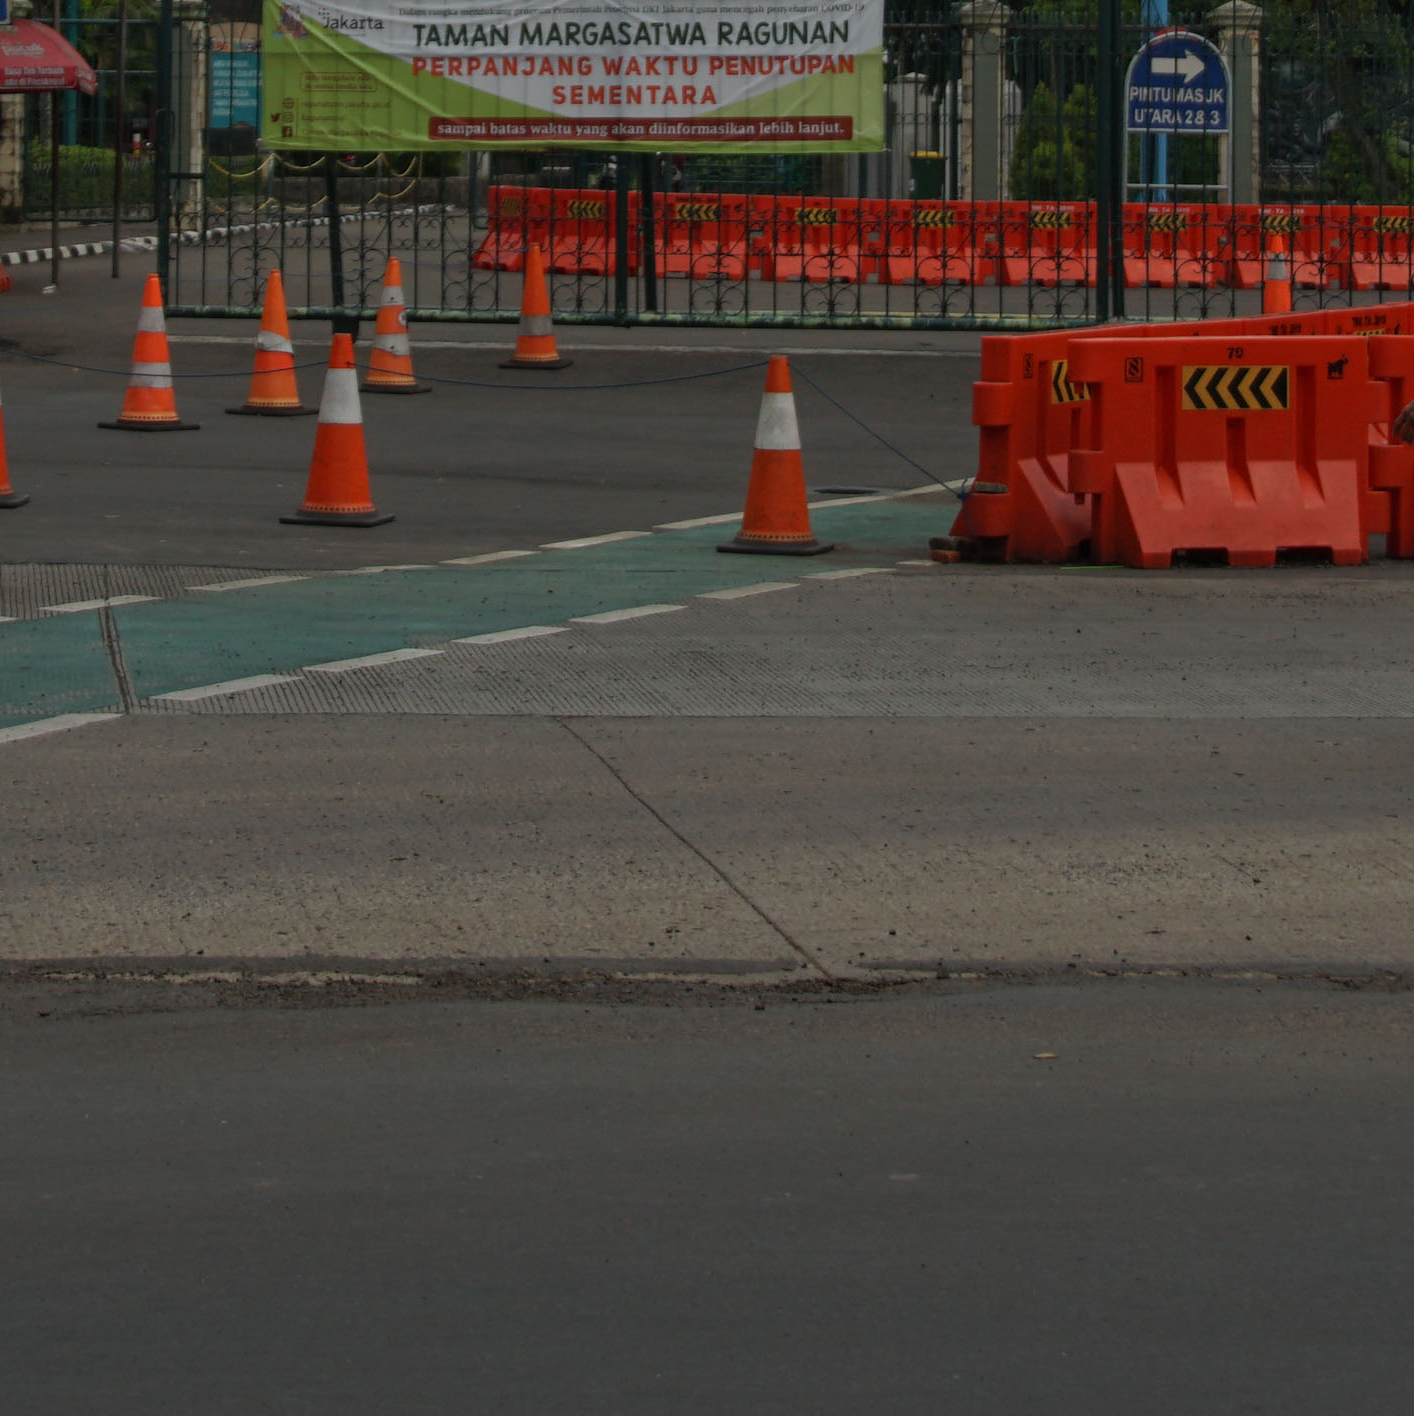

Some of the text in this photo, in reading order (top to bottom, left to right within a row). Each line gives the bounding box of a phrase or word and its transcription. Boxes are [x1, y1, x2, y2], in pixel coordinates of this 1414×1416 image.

[662, 5, 693, 14] Jakarta
[413, 20, 849, 47] TAMAN MARGASATWA RAGUNAN
[412, 54, 855, 76] PERPANJANG WAKTU PENUTUPAN
[552, 85, 717, 105] SEMENTARA
[1129, 86, 1171, 102] PINTU
[1134, 107, 1220, 125] UTARA 2 & 3
[437, 121, 844, 137] sampai batas waktu yang akan diinformasikan lebih lanjut.
[1227, 347, 1244, 359] 79
